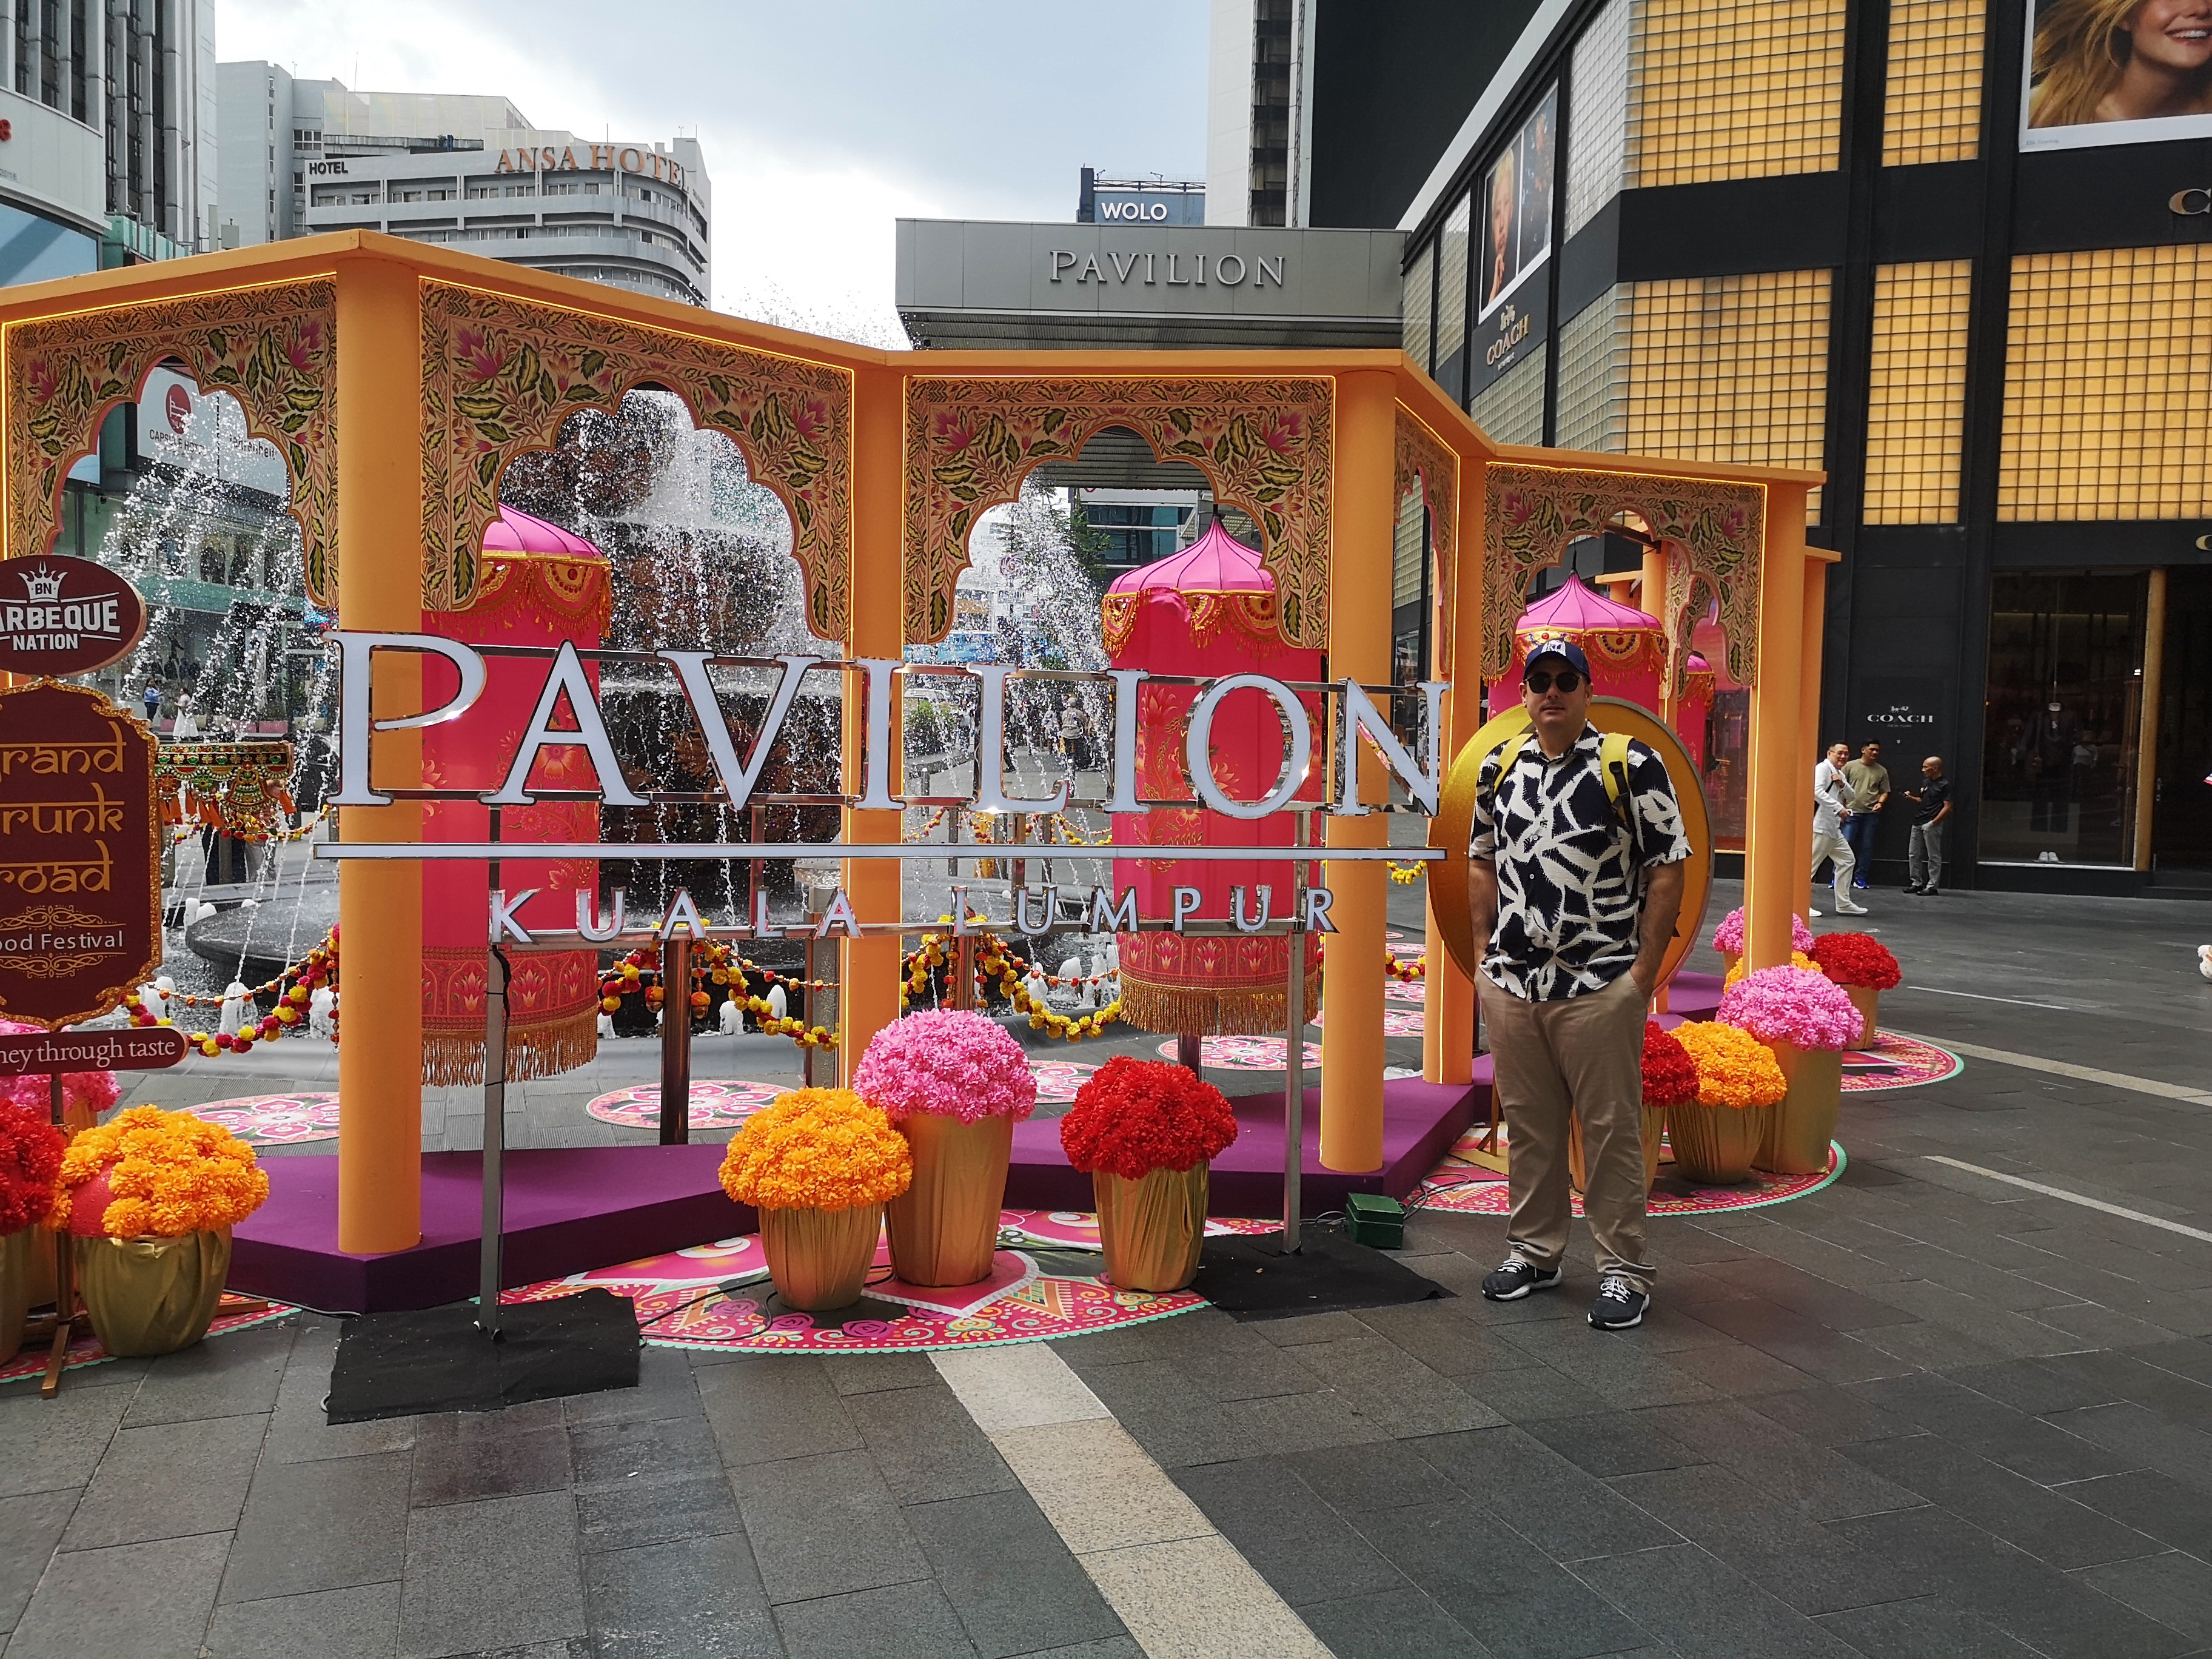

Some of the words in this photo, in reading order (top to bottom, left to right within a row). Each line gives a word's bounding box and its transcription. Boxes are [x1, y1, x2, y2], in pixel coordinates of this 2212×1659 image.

[309, 161, 349, 175] HOTEL
[494, 146, 578, 173] ANSA
[589, 145, 689, 193] HOTEL
[1101, 202, 1168, 221] WOLO
[1049, 249, 1285, 287] PAVILION
[1486, 313, 1529, 365] COACH
[35, 583, 52, 595] BN
[13, 633, 78, 651] NATION
[323, 628, 1451, 818] PAVILION
[1867, 714, 1933, 723] COACH
[0, 721, 127, 782] rand
[489, 886, 863, 942] KUALA
[950, 885, 1340, 935] LUMPUR
[41, 930, 122, 950] Festival
[37, 1037, 124, 1067] through
[129, 1040, 176, 1057] taste
